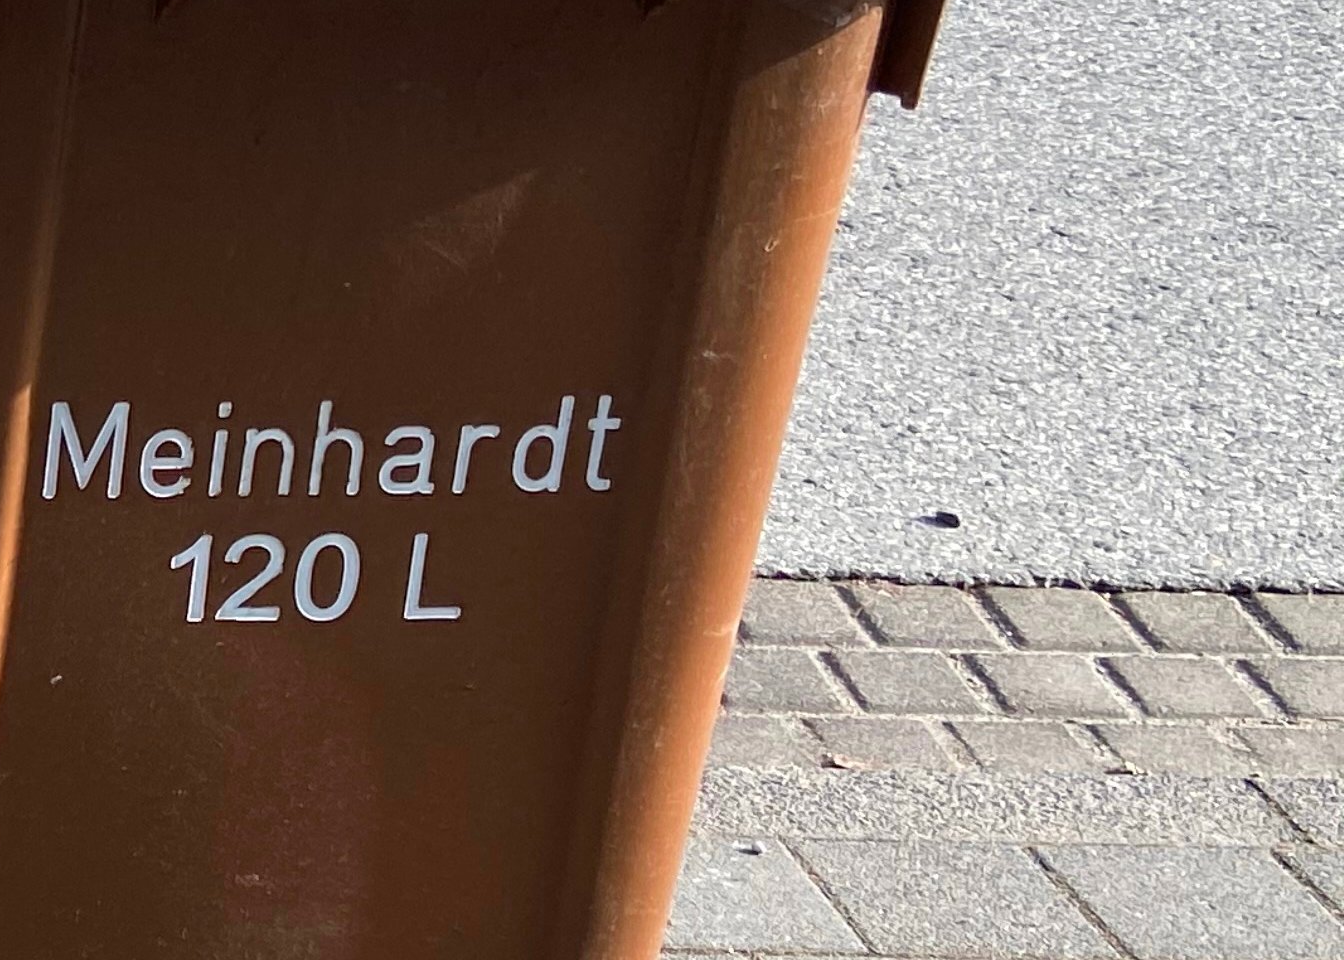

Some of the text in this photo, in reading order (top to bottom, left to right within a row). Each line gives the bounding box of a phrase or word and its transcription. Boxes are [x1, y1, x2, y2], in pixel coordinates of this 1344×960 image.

[41, 394, 622, 500] Meinhardt
[170, 532, 462, 622] 120 L
